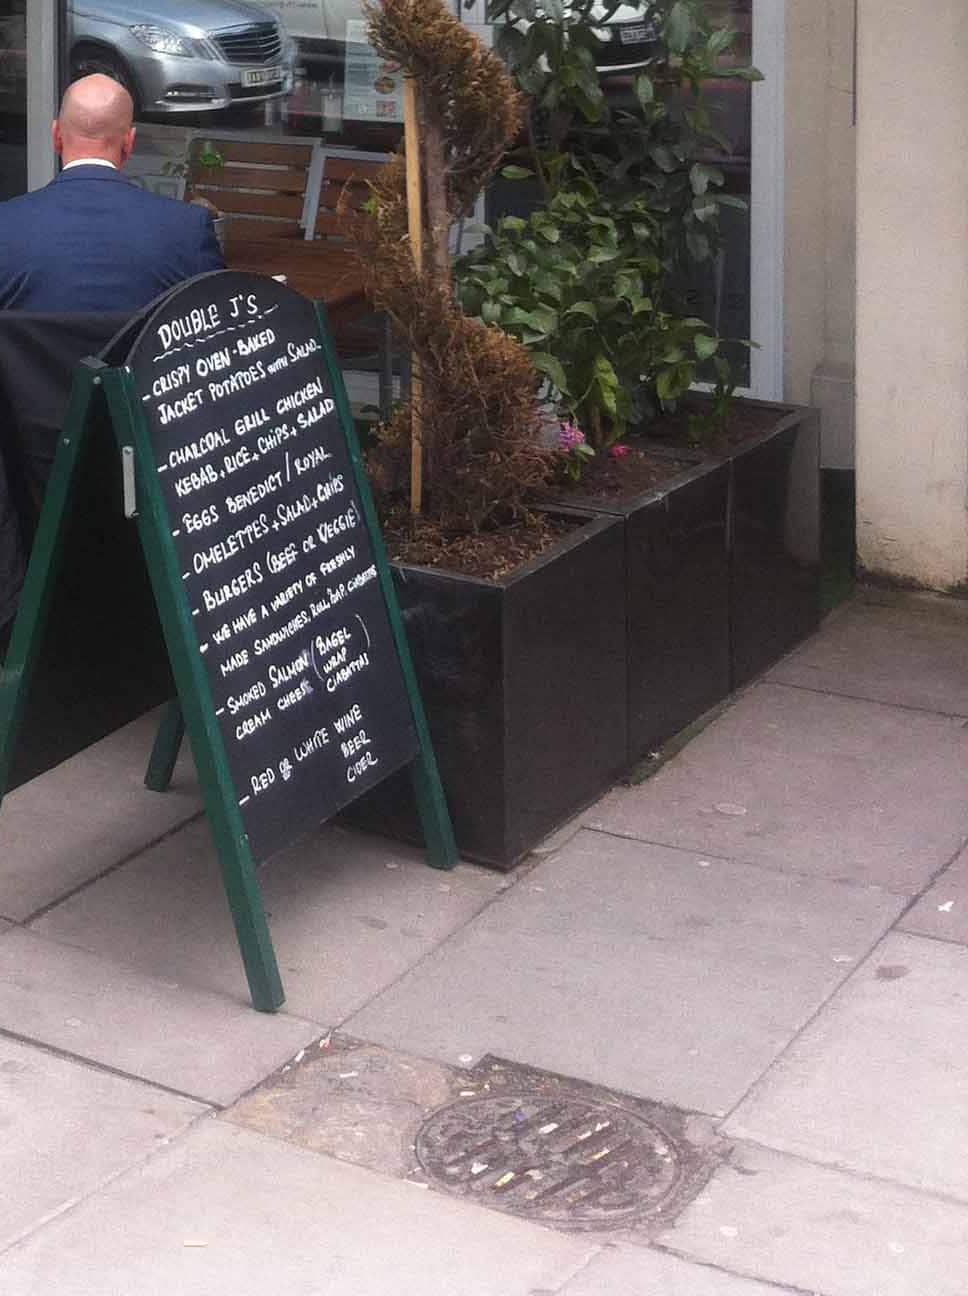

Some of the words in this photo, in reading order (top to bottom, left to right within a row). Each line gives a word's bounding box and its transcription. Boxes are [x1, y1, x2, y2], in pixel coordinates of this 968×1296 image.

[157, 303, 221, 350] DOUBLE
[152, 364, 192, 397] CRISPY
[157, 388, 204, 425] JACKET
[208, 360, 267, 402] POTATOES
[168, 429, 231, 469] CHARCOAL
[234, 408, 271, 436] GRILL
[276, 376, 324, 415] CHICKEN
[297, 398, 335, 430] SALAD
[182, 505, 219, 534] EGGS
[193, 513, 269, 574] OMELETTES
[202, 563, 264, 612] BURGERS
[212, 623, 231, 645] WE
[232, 608, 257, 634] HAVE
[260, 604, 270, 620] A
[305, 572, 318, 587] OF
[315, 626, 353, 656] BAGEL
[220, 649, 249, 678] MADE
[323, 647, 347, 674] WRAP
[226, 681, 267, 715] SMOKED
[268, 650, 311, 689] SALMON
[235, 709, 273, 741] CREAM
[250, 767, 276, 796] RED
[294, 727, 330, 762] WHITE
[334, 703, 363, 734] WINE
[340, 729, 372, 759] BEER
[347, 751, 379, 783] CIDER
